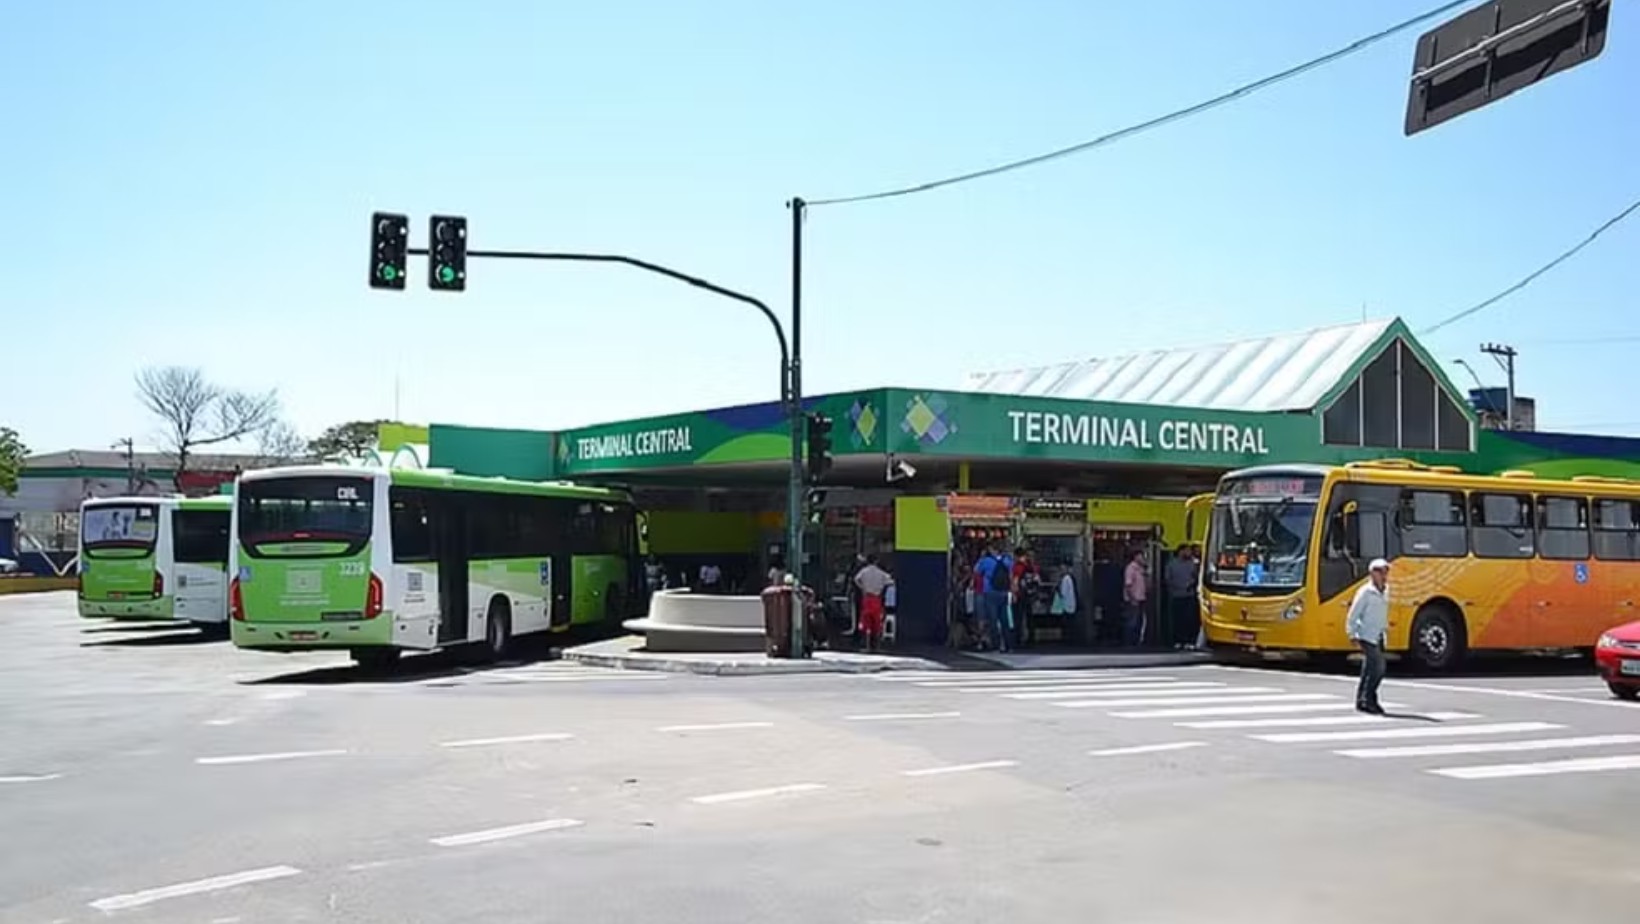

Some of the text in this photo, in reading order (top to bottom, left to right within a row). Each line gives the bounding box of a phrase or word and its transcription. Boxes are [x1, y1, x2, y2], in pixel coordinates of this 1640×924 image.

[577, 426, 692, 460] TERMINAL CENTRAL
[1008, 411, 1268, 454] TERMINAL CENTRAL
